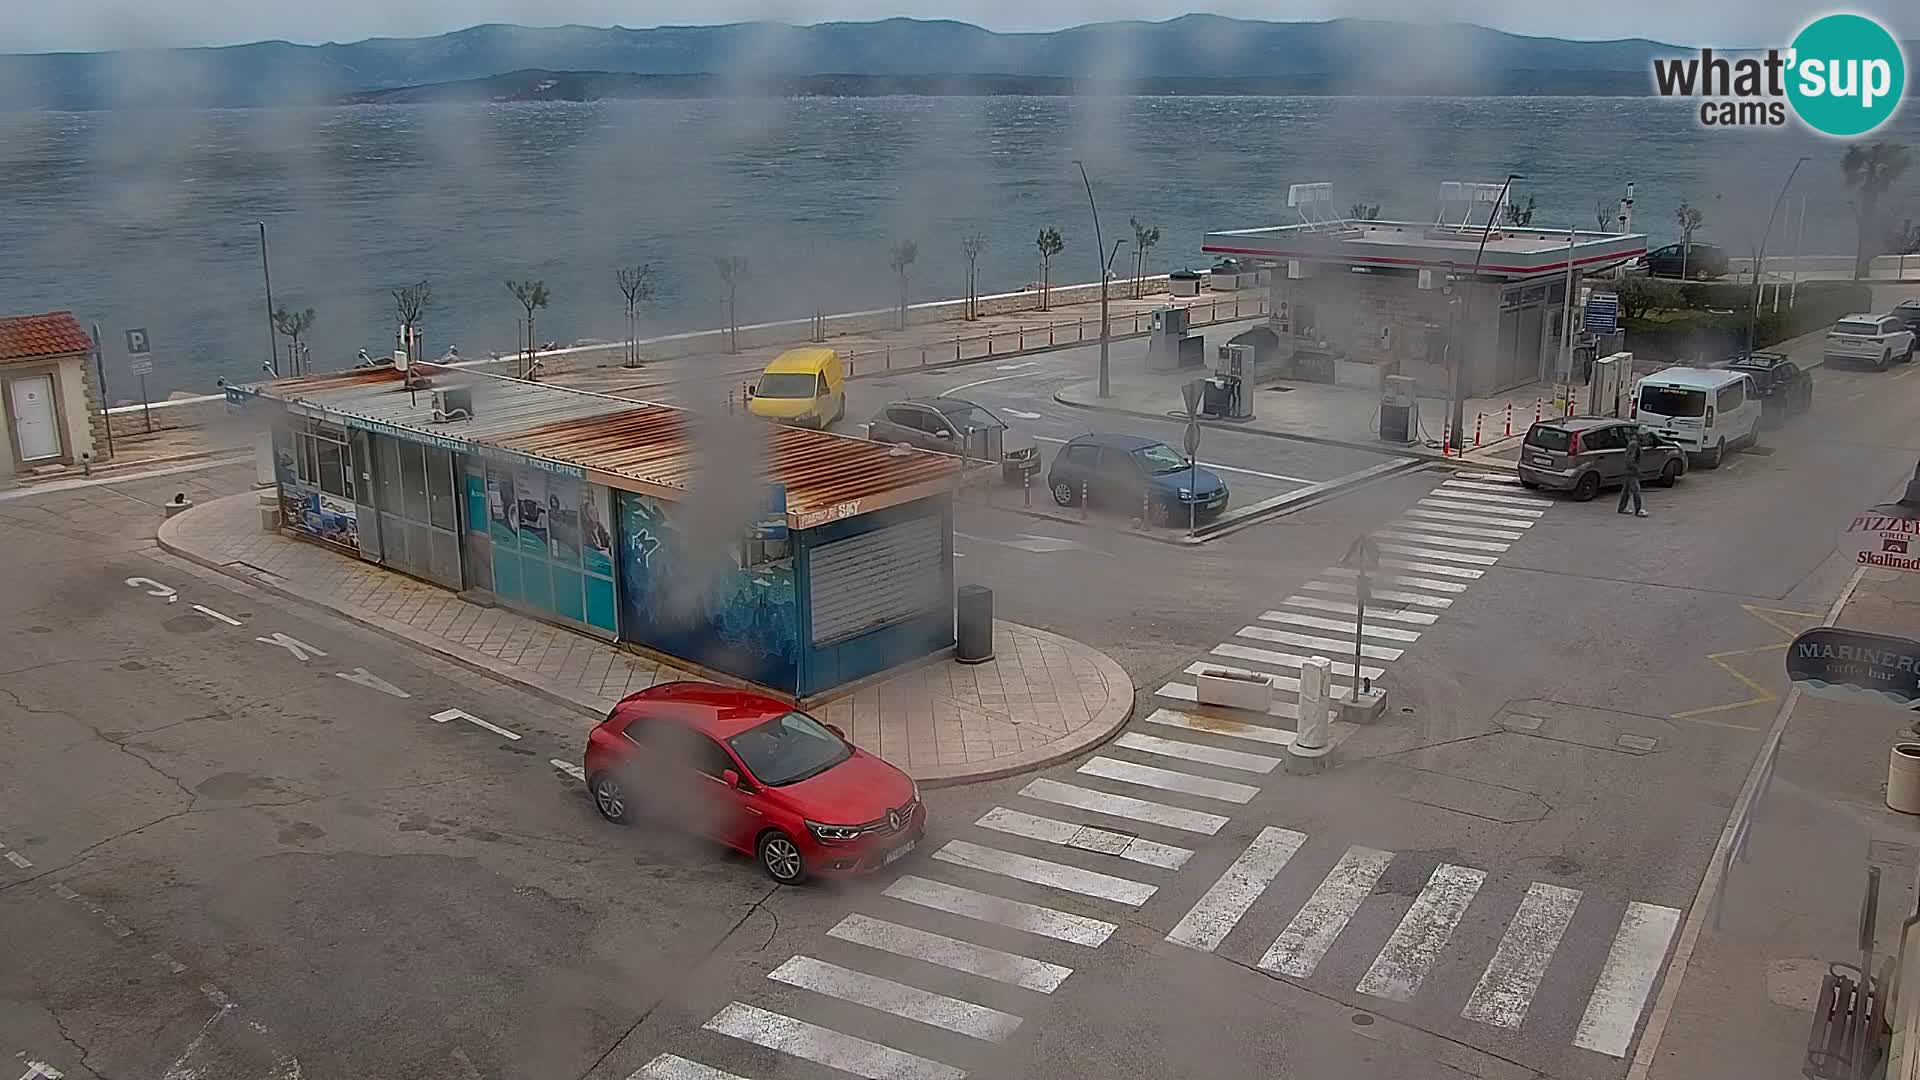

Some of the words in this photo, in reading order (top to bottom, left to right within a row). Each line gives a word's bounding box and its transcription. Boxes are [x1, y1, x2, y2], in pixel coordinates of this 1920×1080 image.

[131, 332, 144, 351] P
[530, 458, 554, 472] TICKET
[555, 463, 582, 478] OFFICE
[1880, 532, 1915, 542] GRILL
[1857, 551, 1920, 570] Skalinad
[1868, 666, 1896, 681] bar
